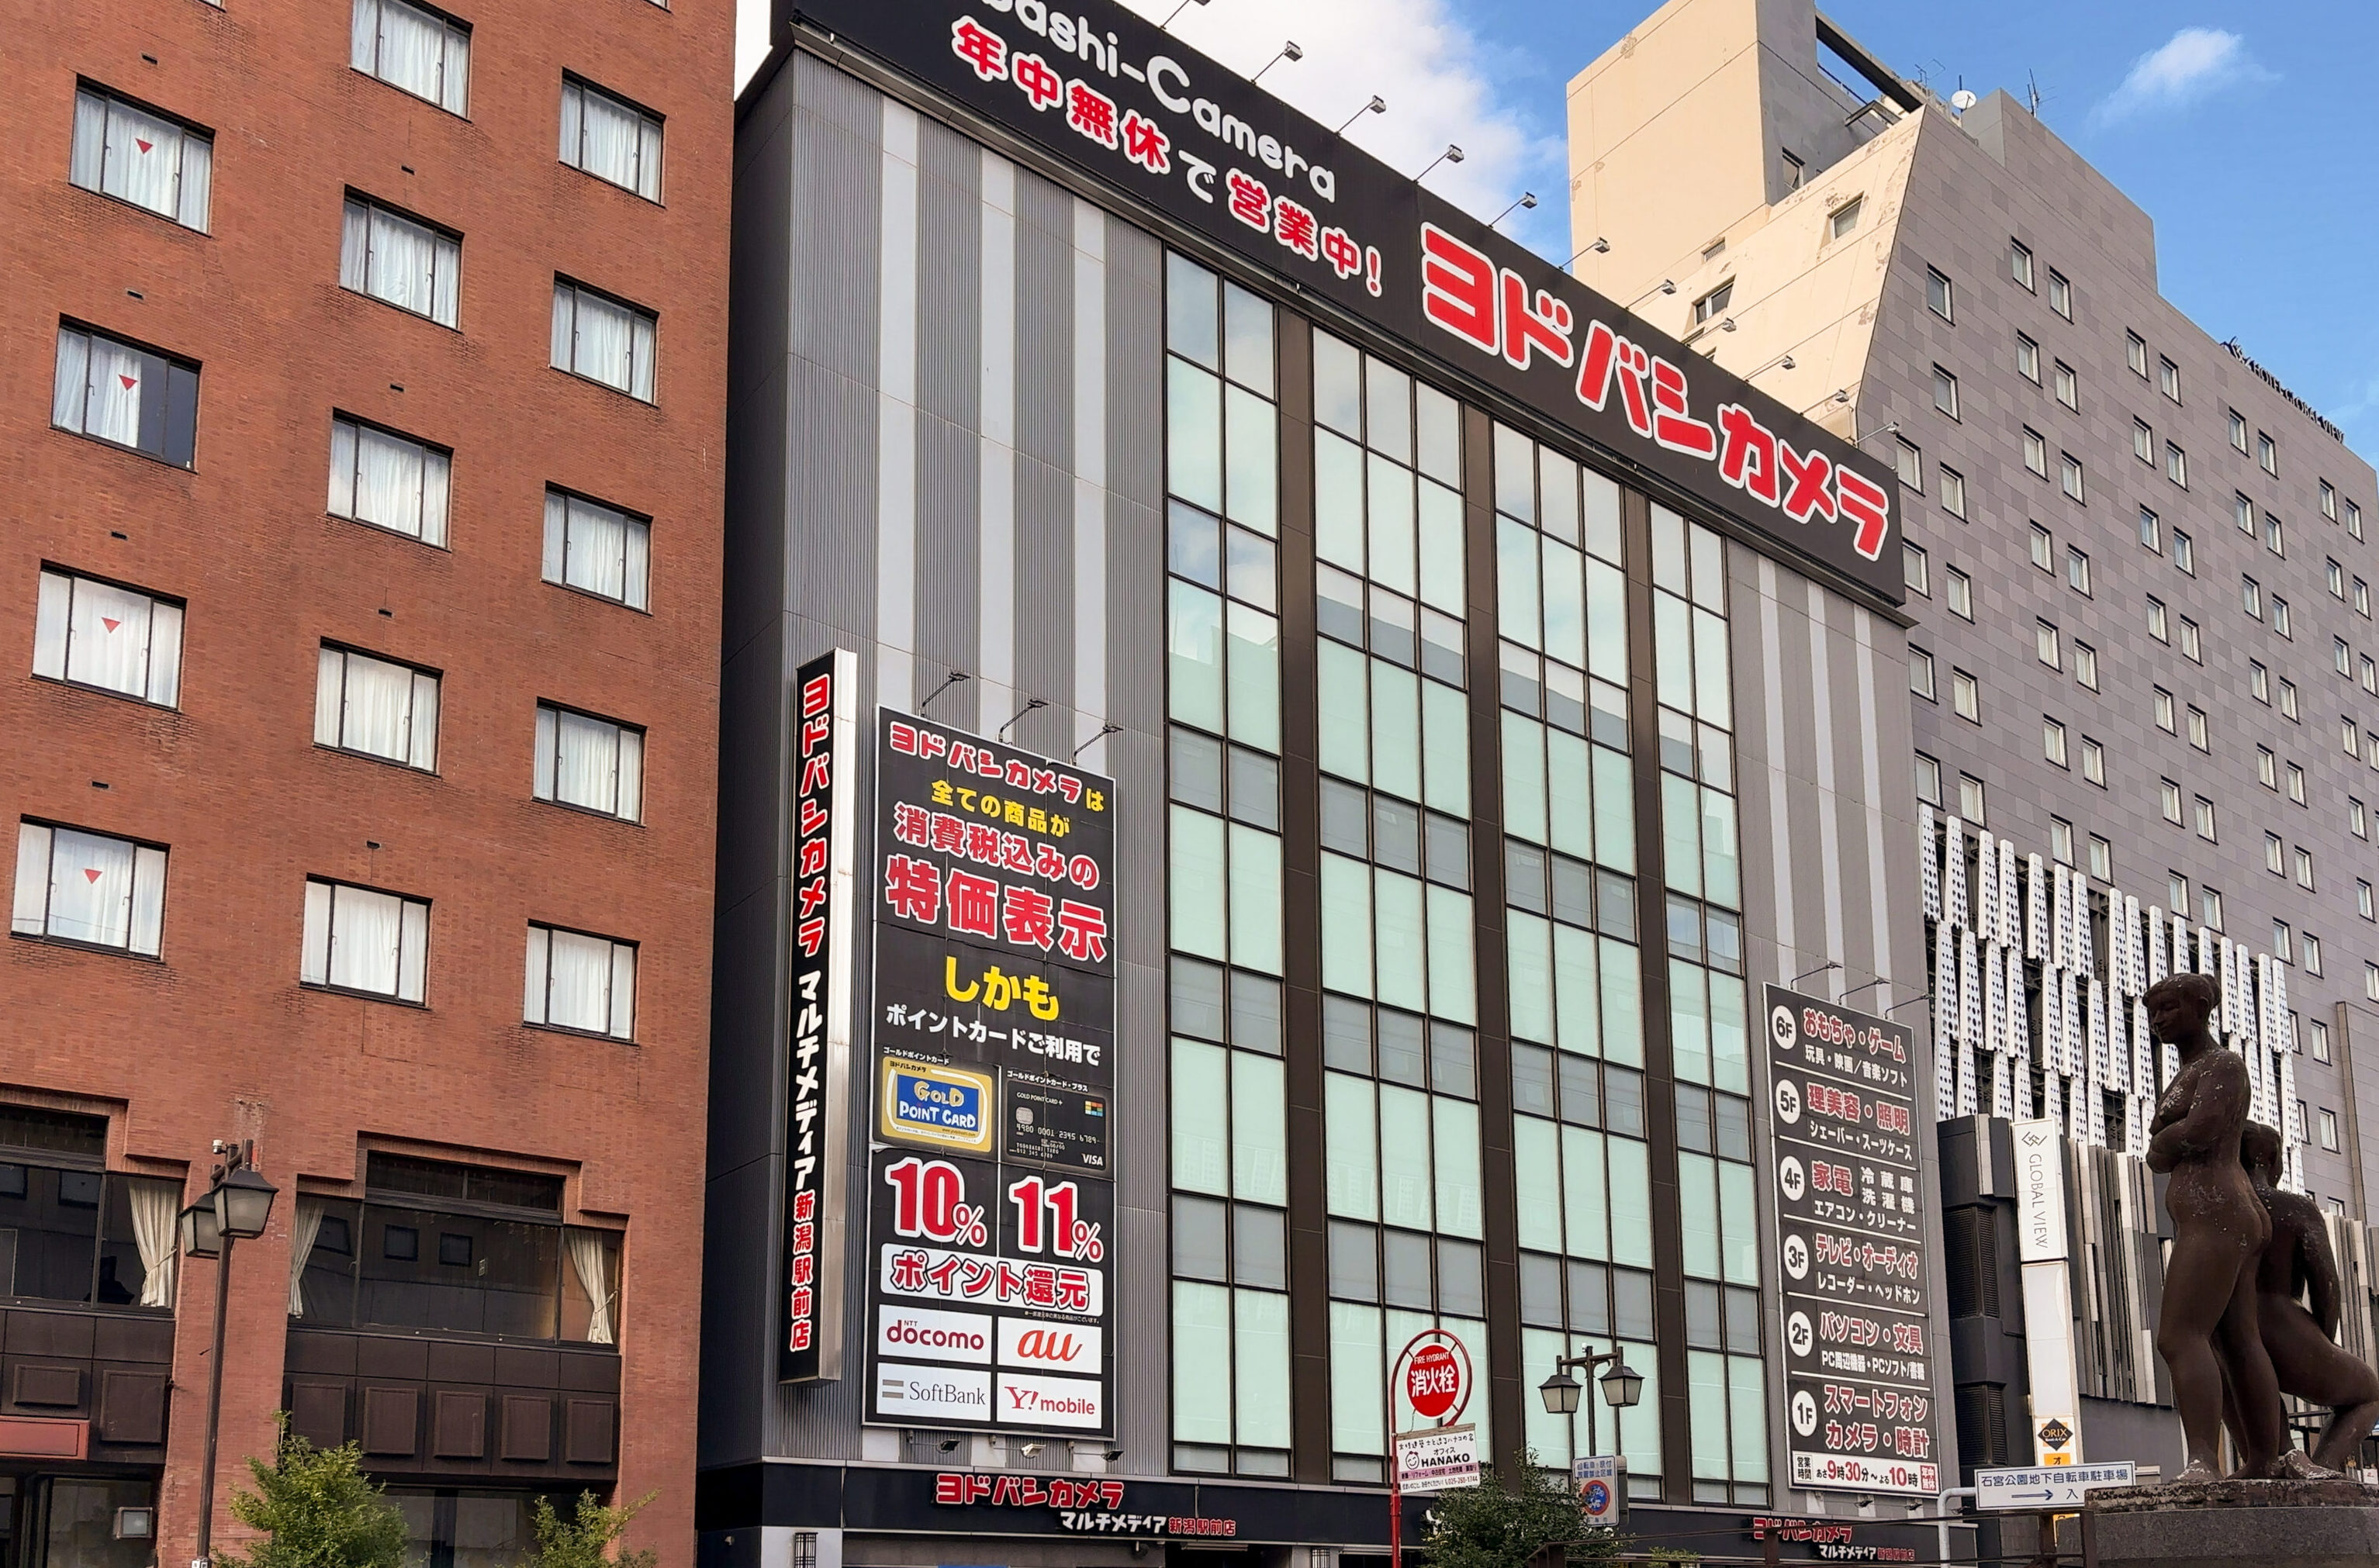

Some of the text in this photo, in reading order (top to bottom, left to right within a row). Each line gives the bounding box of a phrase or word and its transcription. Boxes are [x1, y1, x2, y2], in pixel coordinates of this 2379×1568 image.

[981, 0, 1336, 202] ashi-Camera
[952, 16, 1382, 297] 年中無休で営業中!
[1420, 222, 1889, 561] ヨドバシカメラ
[799, 673, 831, 958] ヨドバシカメラ
[932, 779, 1071, 838] 全ての商品が
[894, 801, 1099, 890] 消費税込みの
[885, 854, 1108, 962] 特価表示
[944, 955, 1060, 1021] しかも
[886, 1003, 1101, 1067] ポイントカードご利用で
[1776, 1016, 1793, 1039] 6F
[1803, 1007, 1906, 1064] おもちゃ・ゲーム
[883, 1047, 950, 1065] ゴールドポイントカード
[914, 1081, 964, 1107] GOLD
[1780, 1090, 1796, 1114] 5F
[1807, 1082, 1910, 1135] 理美容・照明
[899, 1101, 976, 1128] POINT CARD
[1081, 1153, 1103, 1166] VISA
[1785, 1167, 1801, 1190] 4F
[1811, 1161, 1853, 1197] 家電
[884, 1156, 987, 1247] 10%
[1814, 1200, 1917, 1233] エアコン・クリーナー
[2029, 1153, 2049, 1249] GLOBAL VIEW
[1008, 1176, 1104, 1262] 11%
[1788, 1245, 1805, 1269] 3F
[1815, 1233, 1918, 1280] テレビ・オーディオ
[890, 1249, 1090, 1310] ポイント還元
[1817, 1272, 1921, 1305] レコーダー・ヘッドホン
[887, 1319, 984, 1350] docomo
[1017, 1329, 1083, 1362] au
[1792, 1323, 1809, 1345] 2F
[1820, 1311, 1924, 1356] パソコン・文具
[1414, 1352, 1450, 1365] FIRE HYDRANT
[909, 1381, 986, 1405] SoftBank
[1411, 1364, 1456, 1397] 消火栓
[1797, 1402, 1813, 1425] 1F
[1824, 1384, 1928, 1422] スマートフォン
[1825, 1419, 1930, 1459] カメラ・時計
[2042, 1428, 2068, 1438] ORIX
[1421, 1453, 1470, 1467] HANAKO
[1433, 1447, 1456, 1456] オフィス
[935, 1473, 1125, 1509] ヨドバシカメラ
[1981, 1469, 2128, 1487] 石宮公園地下自転車駐車場
